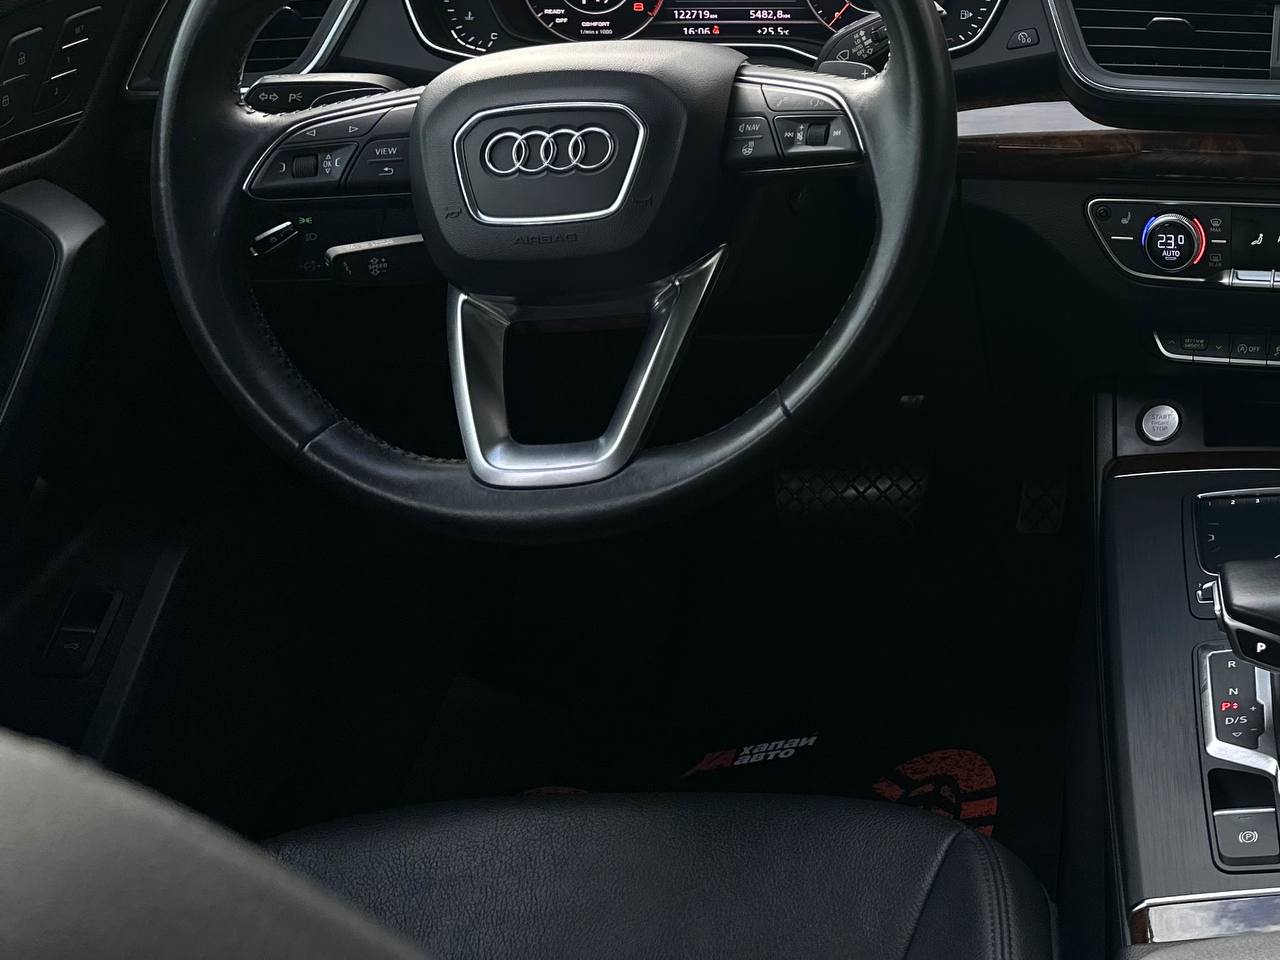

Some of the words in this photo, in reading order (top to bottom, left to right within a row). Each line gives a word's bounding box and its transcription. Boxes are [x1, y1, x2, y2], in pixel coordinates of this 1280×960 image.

[633, 3, 644, 11] 8
[375, 147, 397, 156] VIEW
[1256, 642, 1266, 653] P
[1221, 702, 1231, 710] P
[1225, 716, 1248, 725] D/S
[733, 748, 796, 766] авто
